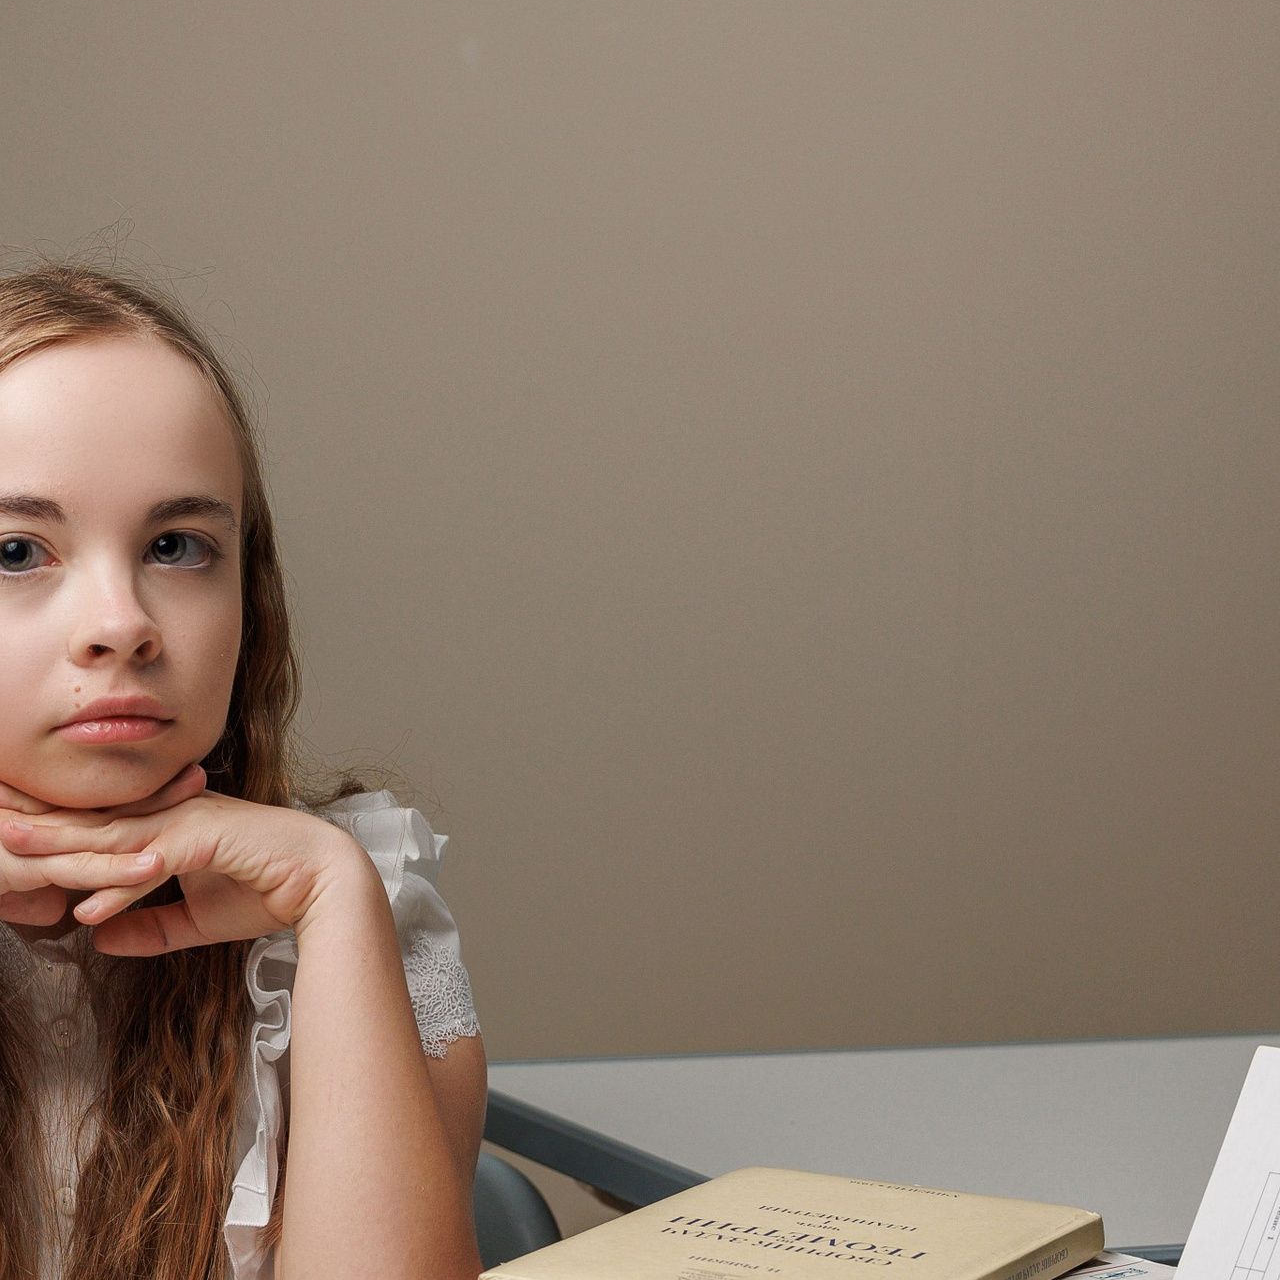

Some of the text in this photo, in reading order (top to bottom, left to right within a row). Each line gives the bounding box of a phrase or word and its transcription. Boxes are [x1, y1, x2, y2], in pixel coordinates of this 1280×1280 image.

[661, 1227, 892, 1265] СБОРНИК ЗАДАЧ
[669, 1216, 926, 1259] ГЕОМЕТРИИ
